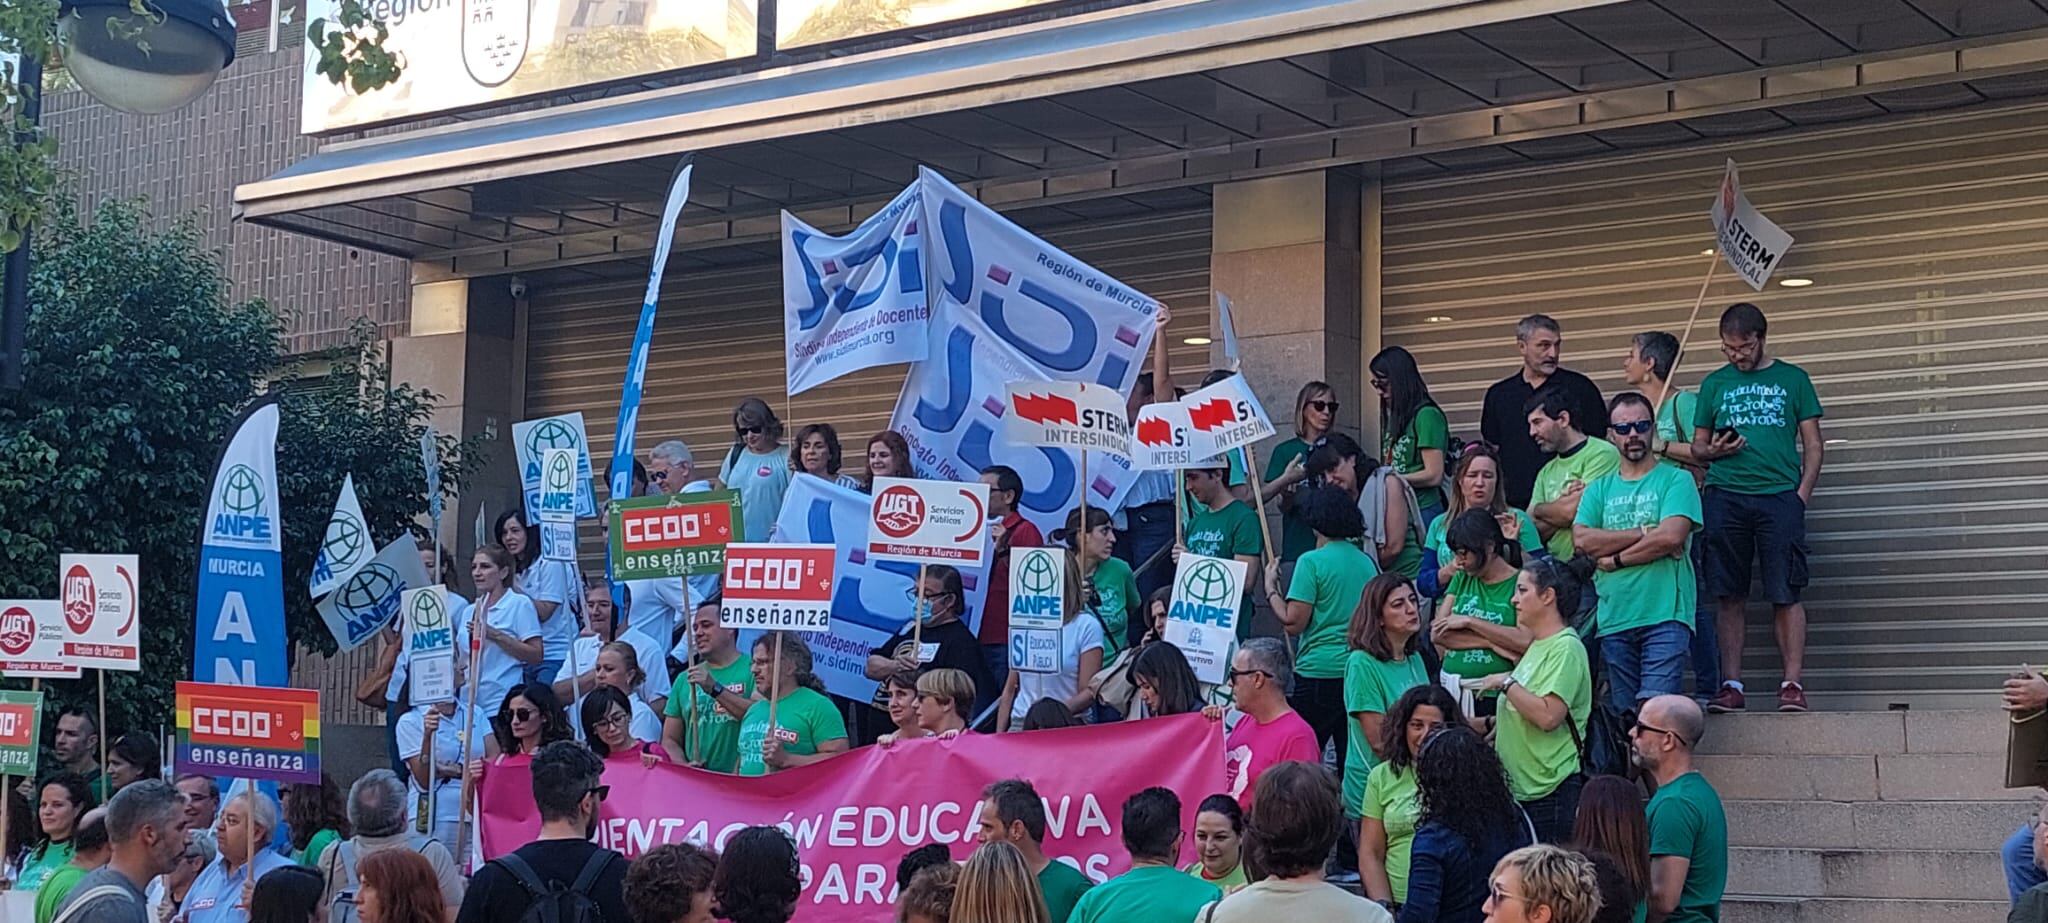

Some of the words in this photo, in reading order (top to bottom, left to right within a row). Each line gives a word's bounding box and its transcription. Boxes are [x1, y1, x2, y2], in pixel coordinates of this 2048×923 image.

[361, 0, 450, 26] egi
[1718, 222, 1761, 284] RSINDICAL
[1729, 218, 1775, 270] STERM
[1036, 252, 1083, 283] Región
[1085, 277, 1103, 292] de
[1105, 285, 1153, 316] Murcia
[876, 303, 930, 326] Docente
[1082, 408, 1129, 440] STERM
[541, 492, 575, 510] ANPE
[882, 493, 920, 518] UGT
[930, 505, 966, 516] Servicios
[213, 512, 272, 538] ANPE
[624, 513, 700, 543] CCOO
[929, 515, 962, 526] Públicos
[625, 549, 727, 570] enseñanz
[887, 545, 916, 556] Región
[918, 548, 929, 556] de
[931, 548, 963, 558] Murcia
[208, 558, 265, 577] MURCIA
[725, 558, 802, 590] CCOO
[66, 576, 92, 602] UGT
[721, 603, 829, 627] enseñanza
[1012, 594, 1062, 616] ANPE
[1169, 600, 1234, 629] ANPE
[1, 614, 31, 634] UGT
[410, 627, 451, 651] ANPE
[815, 631, 873, 658] Independie
[193, 707, 271, 739] CCOO
[191, 747, 304, 771] enseñanza
[828, 792, 1112, 848] EDUCVA
[798, 862, 902, 905] PAR
